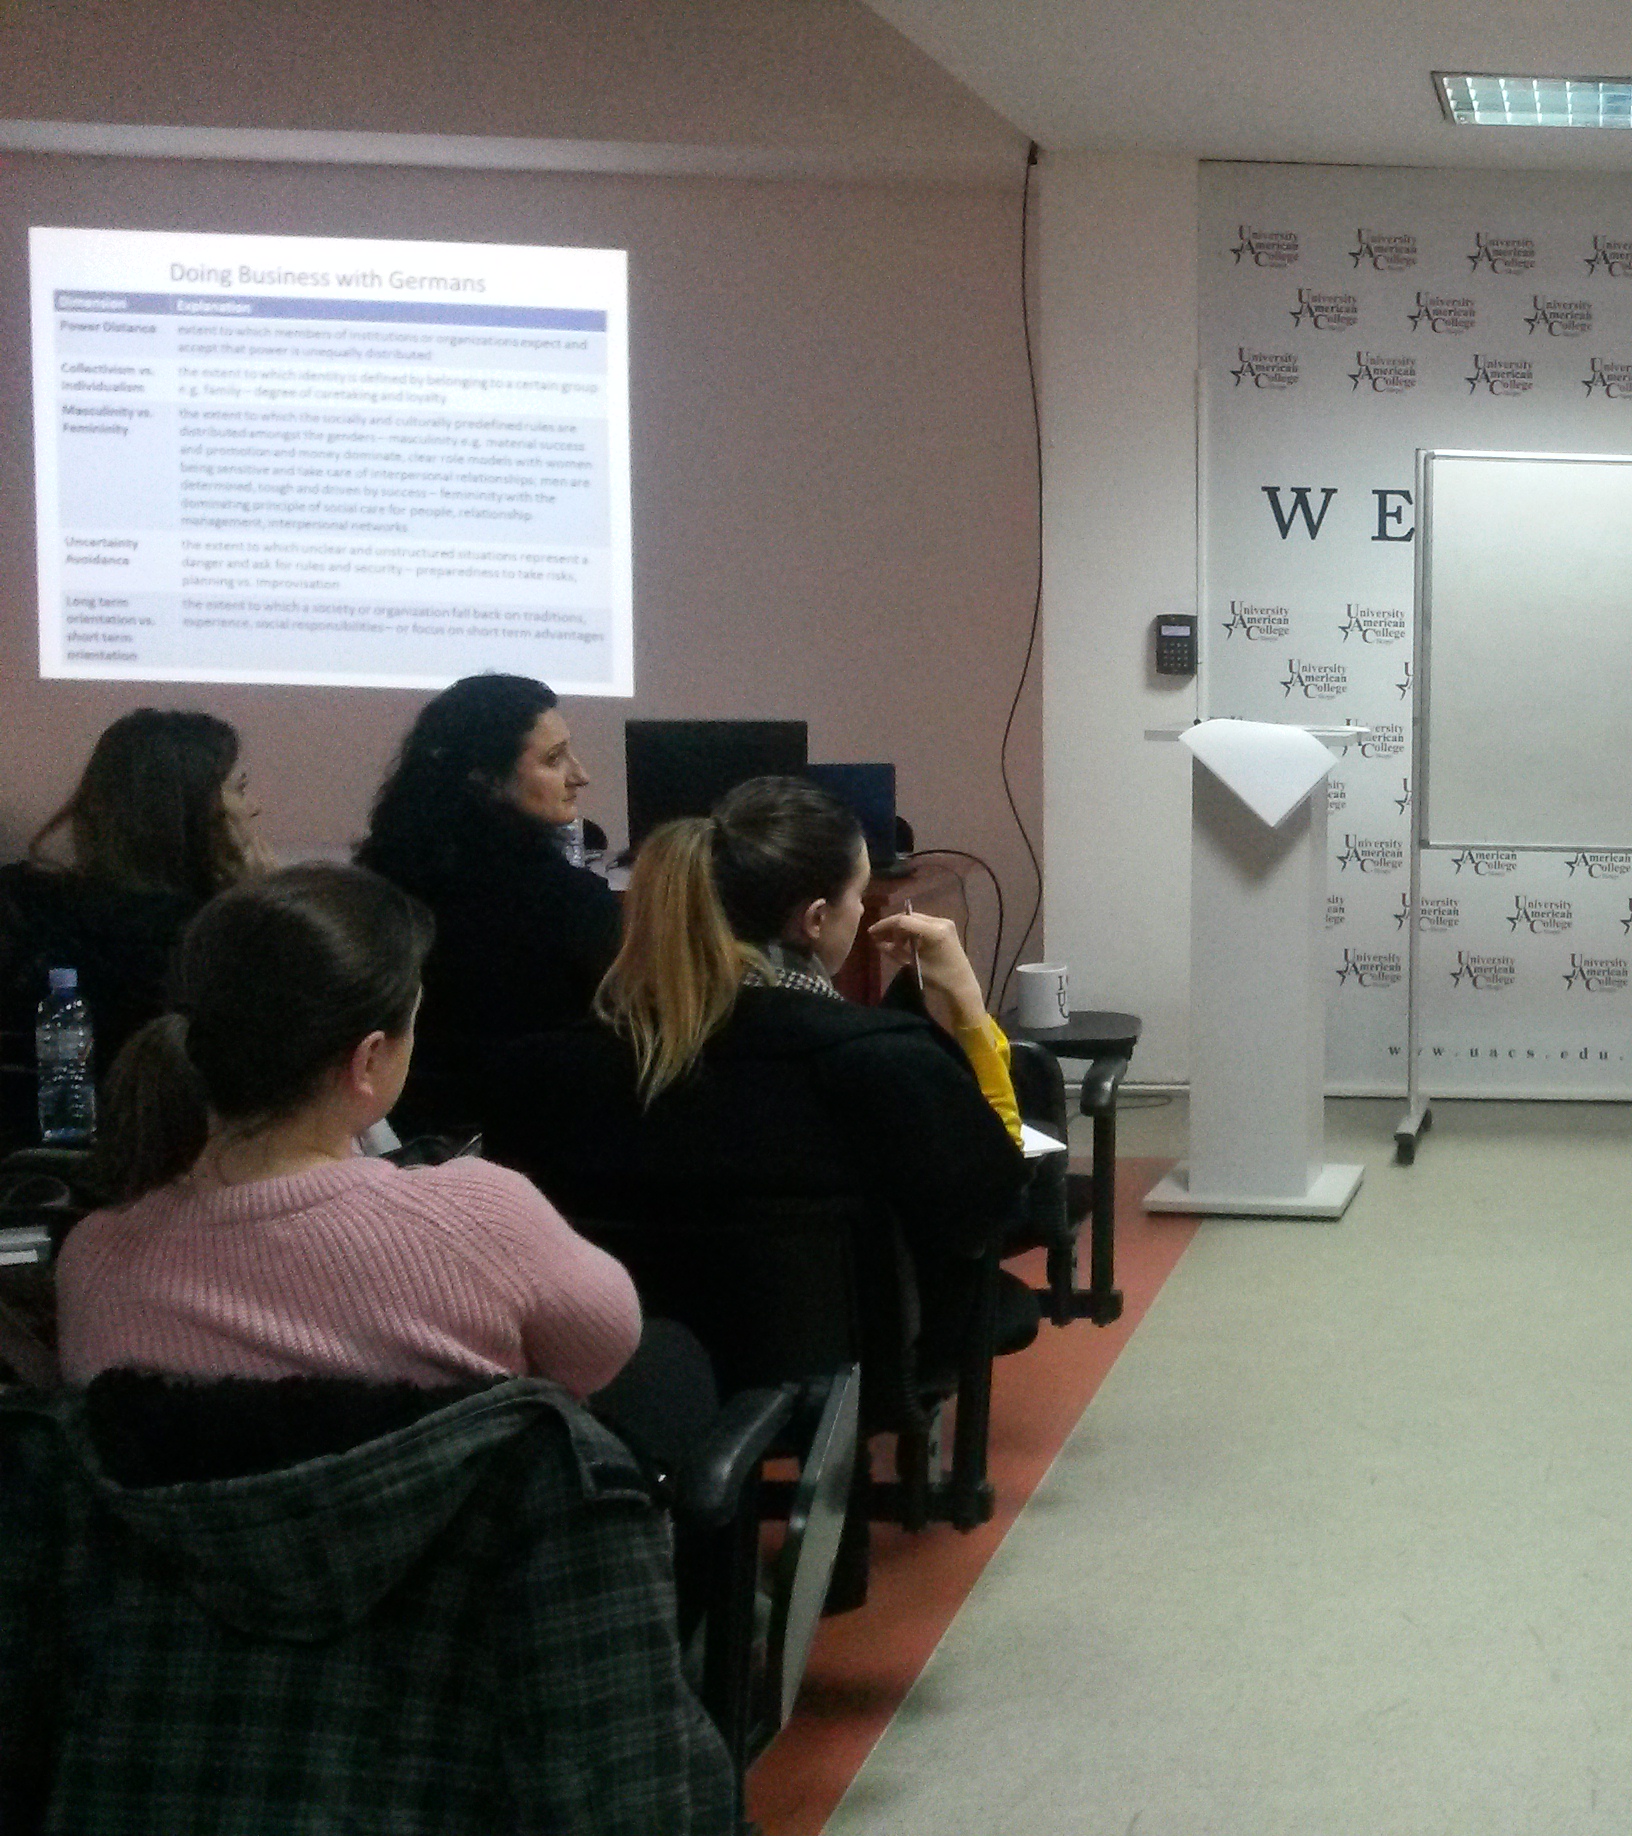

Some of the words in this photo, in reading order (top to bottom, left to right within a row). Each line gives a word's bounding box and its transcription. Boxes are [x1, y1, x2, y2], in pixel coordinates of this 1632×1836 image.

[1239, 225, 1298, 241] University
[1357, 228, 1417, 244] University
[1476, 232, 1535, 248] University
[1244, 240, 1298, 254] American
[1362, 243, 1417, 257] American
[1481, 247, 1535, 261] American
[1255, 251, 1298, 267] College
[1373, 255, 1417, 270] College
[1492, 258, 1535, 274] College
[170, 263, 232, 287] Doing
[238, 265, 330, 286] Business
[335, 269, 383, 288] with
[388, 270, 486, 292] Germans
[1298, 288, 1358, 304] University
[1416, 292, 1476, 308] University
[1533, 294, 1592, 311] University
[1302, 303, 1358, 317] American
[1421, 307, 1476, 320] American
[1538, 310, 1592, 324] American
[1314, 314, 1358, 330] College
[1432, 318, 1476, 333] College
[1549, 321, 1592, 336] College
[1238, 348, 1299, 363] University
[1356, 351, 1416, 367] University
[1474, 354, 1533, 370] University
[1244, 362, 1299, 375] American
[1362, 366, 1416, 380] American
[1478, 369, 1533, 383] American
[1254, 373, 1299, 388] College
[1372, 377, 1416, 392] College
[1490, 380, 1533, 396] College
[1230, 601, 1289, 616] University
[1346, 604, 1406, 619] University
[1235, 615, 1289, 628] American
[1352, 618, 1406, 631] American
[1246, 626, 1289, 640] College
[1362, 629, 1406, 644] College
[1288, 659, 1347, 674] University
[1293, 673, 1347, 686] American
[1304, 684, 1347, 698] College
[1361, 743, 1404, 758] College
[1345, 834, 1403, 849] University
[1350, 848, 1403, 861] American
[1462, 850, 1517, 864] American
[1577, 853, 1631, 866] American
[1361, 858, 1403, 872] College
[1474, 861, 1517, 875] College
[1588, 863, 1631, 879] College
[1402, 893, 1460, 908] Uiversity
[1514, 896, 1572, 910] University
[1520, 909, 1572, 922] American
[1530, 919, 1572, 934] College
[1344, 949, 1401, 964] University
[1458, 951, 1515, 966] University
[1570, 954, 1628, 969] University
[1349, 963, 1401, 975] American
[1462, 965, 1515, 978] American
[1576, 968, 1628, 980] American
[1360, 973, 1401, 987] College
[1474, 975, 1515, 990] College
[1586, 978, 1628, 992] College
